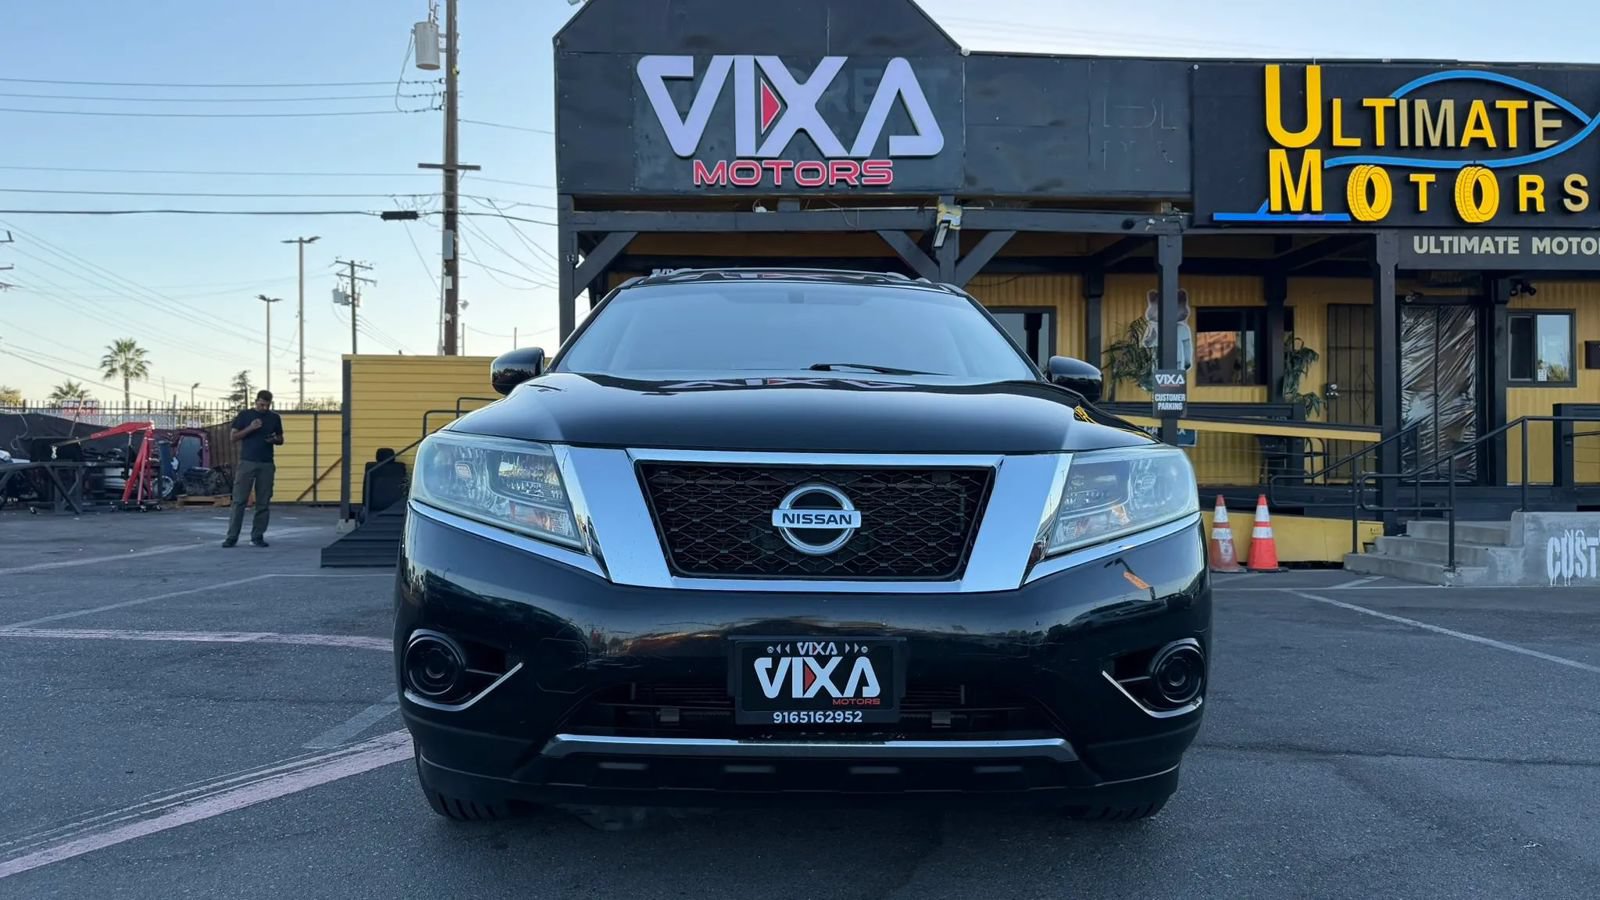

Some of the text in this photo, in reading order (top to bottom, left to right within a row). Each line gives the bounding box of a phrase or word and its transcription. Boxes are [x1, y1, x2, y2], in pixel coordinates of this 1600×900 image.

[636, 54, 944, 157] VIXA
[1265, 64, 1562, 148] ULTIMATE
[693, 159, 893, 186] MOTORS
[1269, 149, 1590, 223] MOTORS
[1413, 236, 1600, 255] ULTIMATE MOTO
[1155, 374, 1185, 385] VIXA
[1154, 394, 1186, 402] CUSTOMER
[1157, 402, 1183, 411] PARKING
[782, 513, 852, 525] NISSAN
[797, 641, 838, 655] VIXA
[753, 656, 881, 699] VIXA
[772, 710, 863, 724] 9165162952
